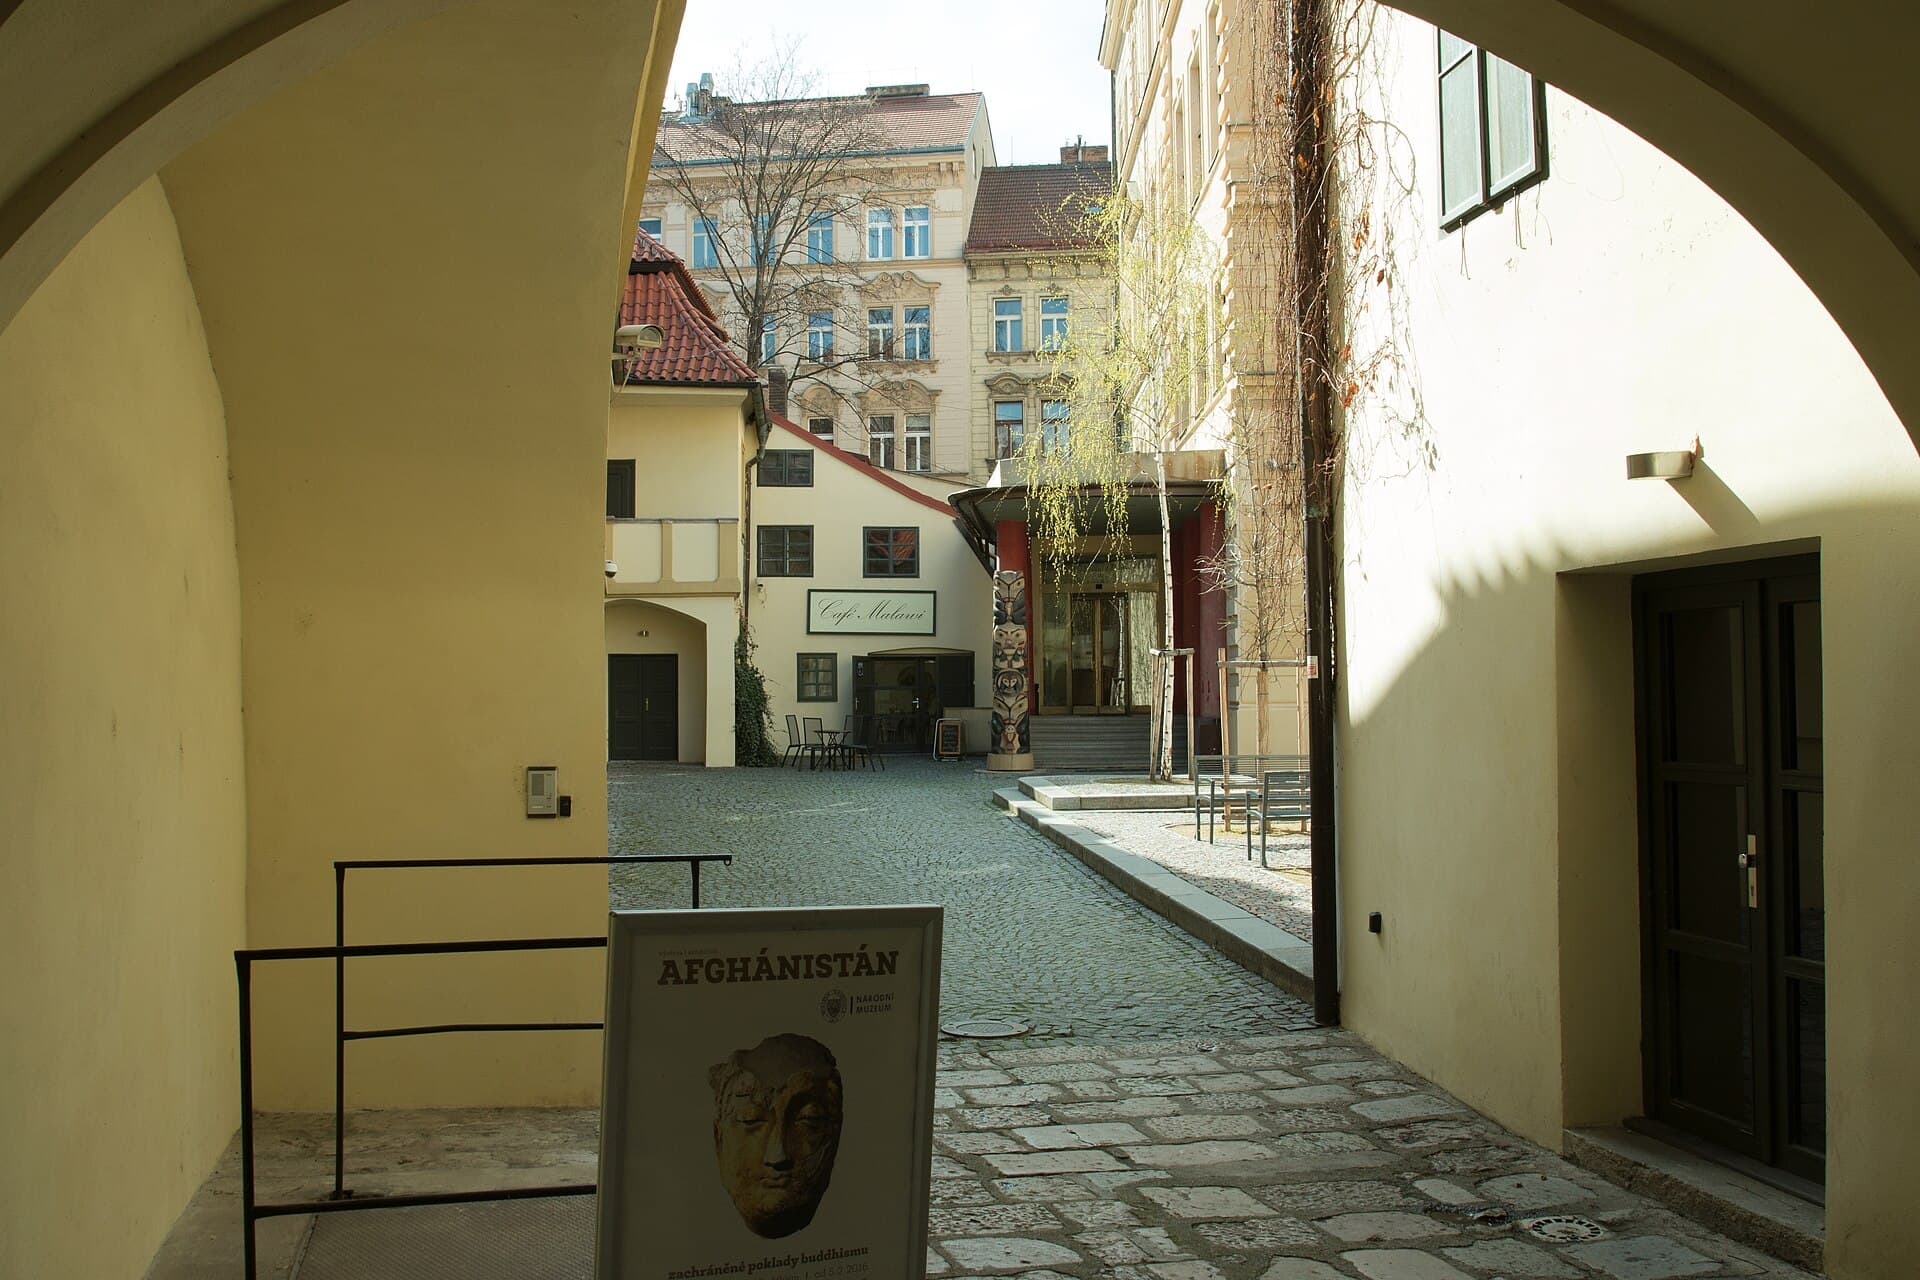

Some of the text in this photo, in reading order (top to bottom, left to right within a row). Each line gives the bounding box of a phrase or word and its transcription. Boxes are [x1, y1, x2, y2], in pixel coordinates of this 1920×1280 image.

[817, 599, 927, 626] Café Malawi
[656, 943, 899, 986] AFGHÁNISTÁN
[856, 1003, 893, 1015] MUZEUM
[667, 1246, 869, 1280] zachráněné poklady buddhismu
